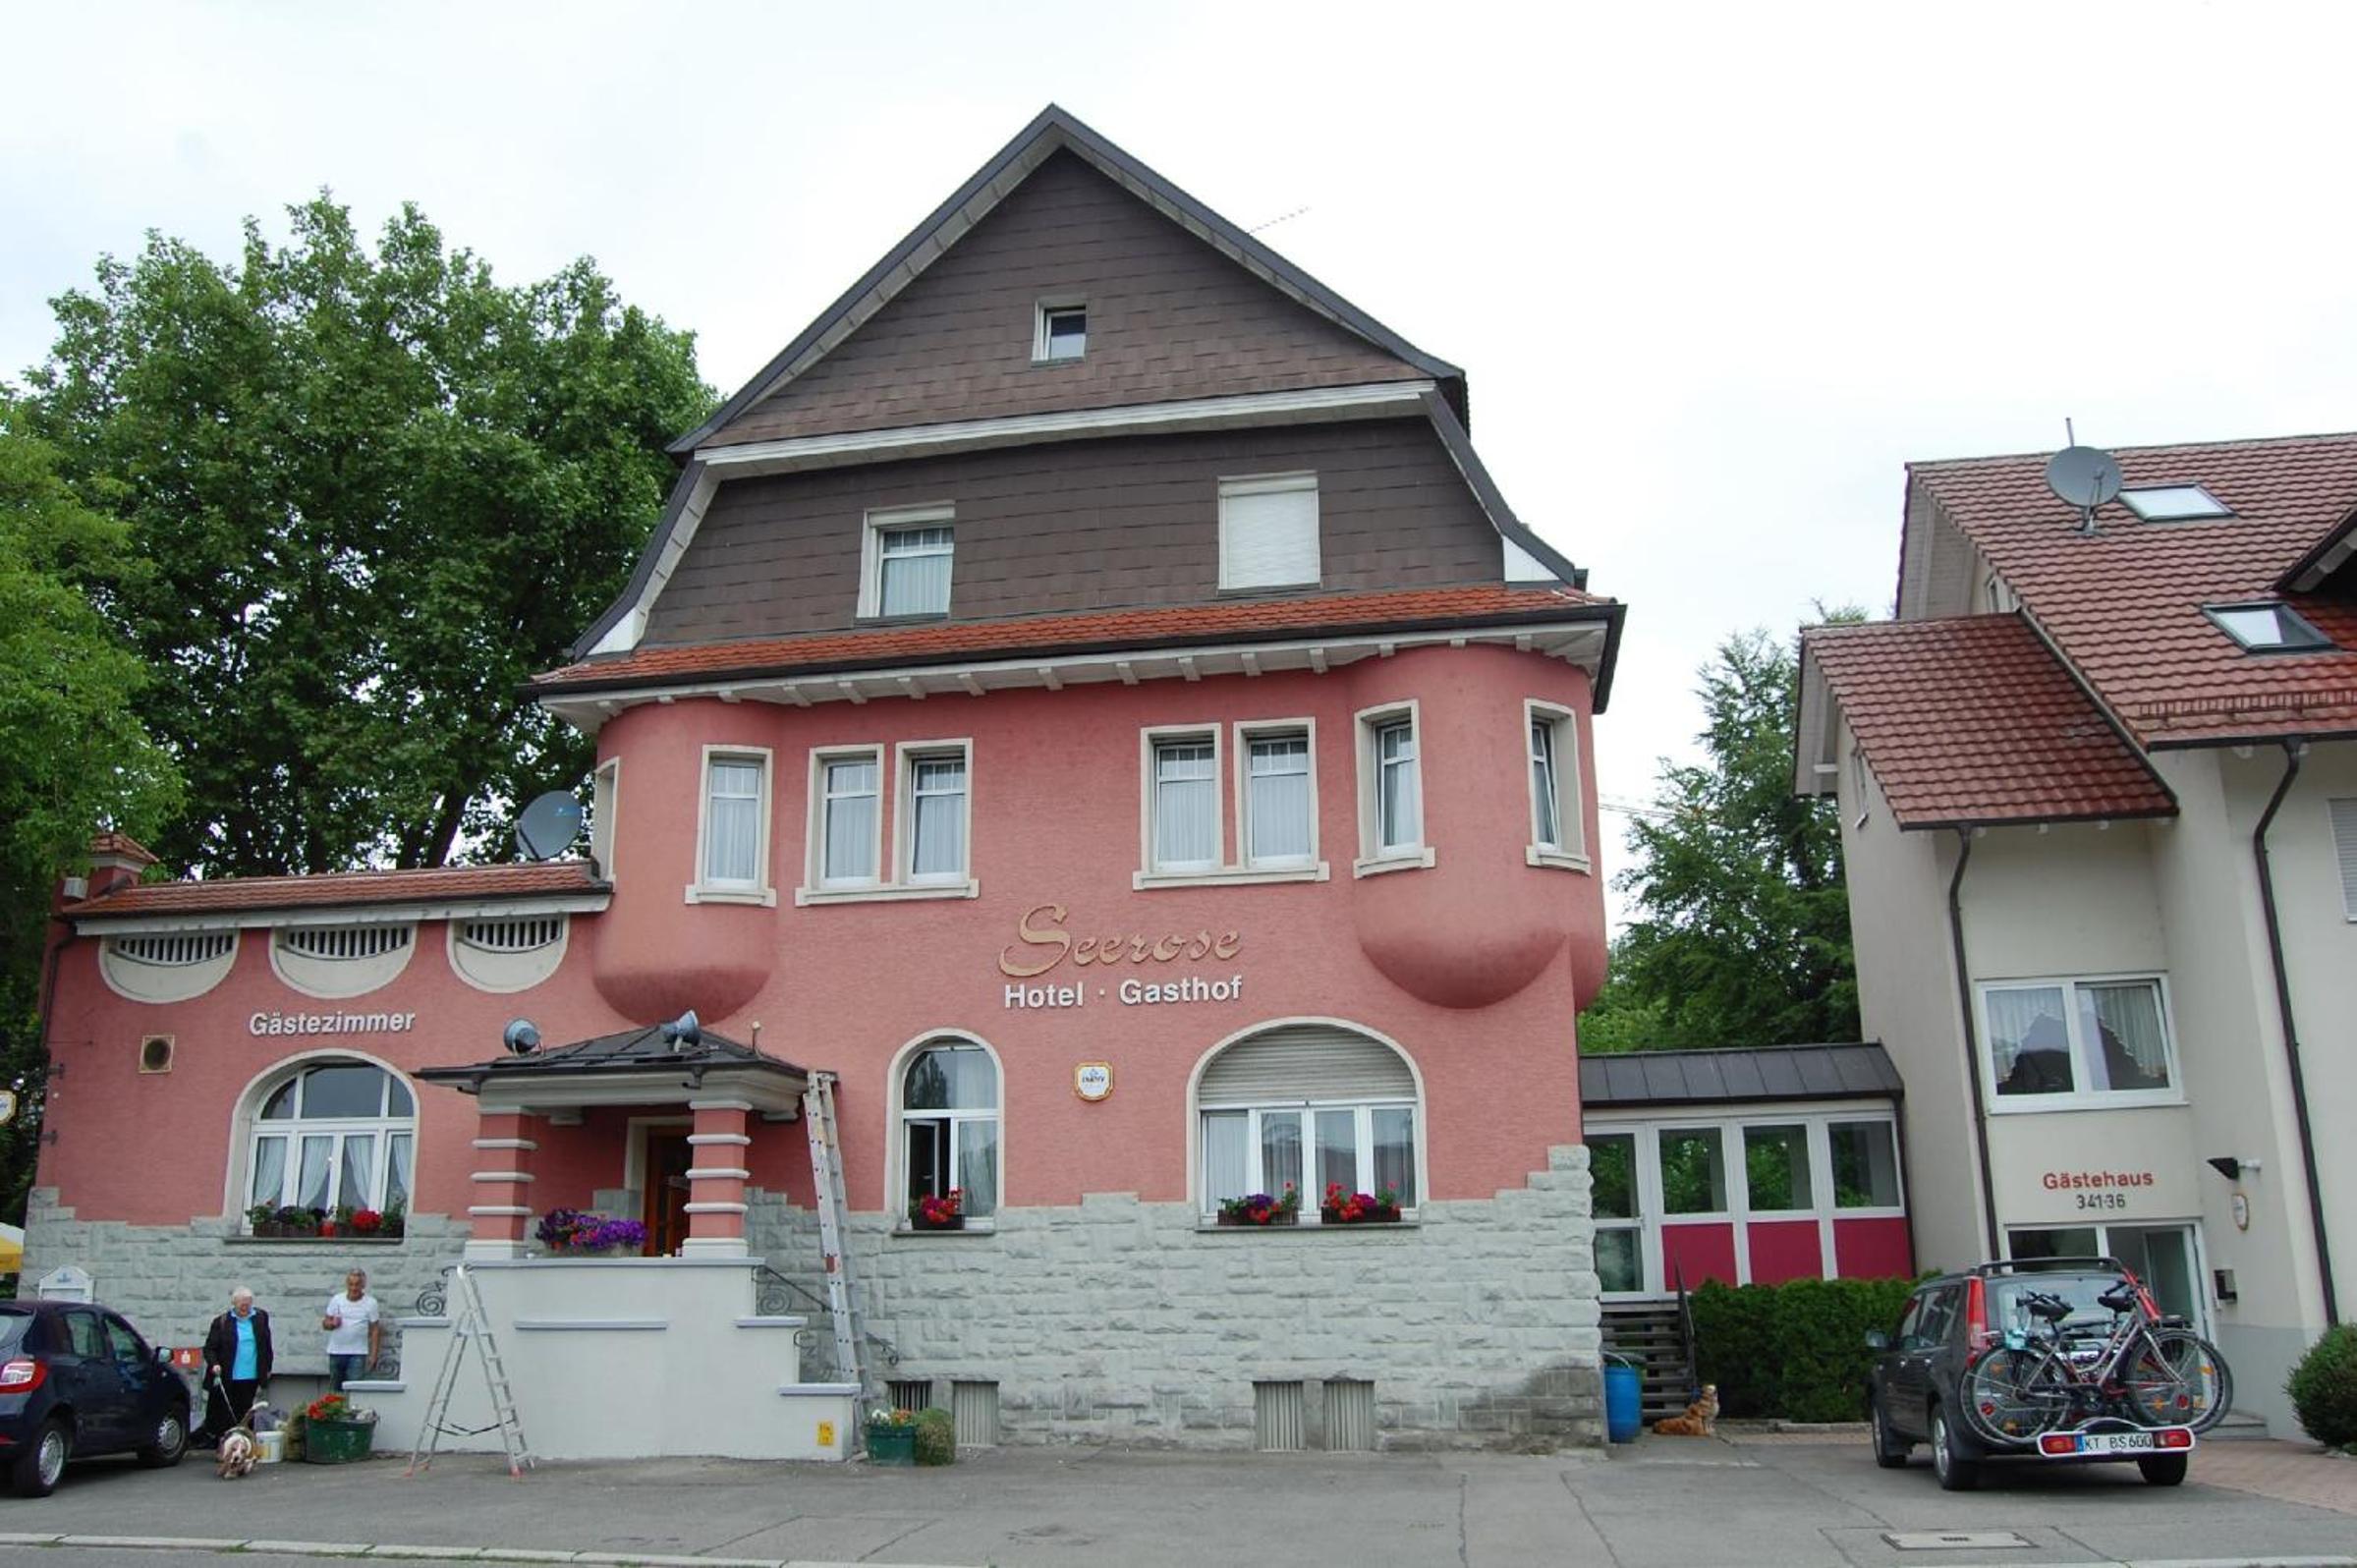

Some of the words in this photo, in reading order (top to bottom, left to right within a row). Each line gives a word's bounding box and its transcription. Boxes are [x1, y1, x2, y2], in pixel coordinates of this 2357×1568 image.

[998, 903, 1242, 977] Seerose
[1004, 981, 1084, 1008] Hotel
[1119, 976, 1242, 1005] Gasthof
[250, 1011, 416, 1035] Gästezimmer
[2044, 1171, 2154, 1190] Gästehaus
